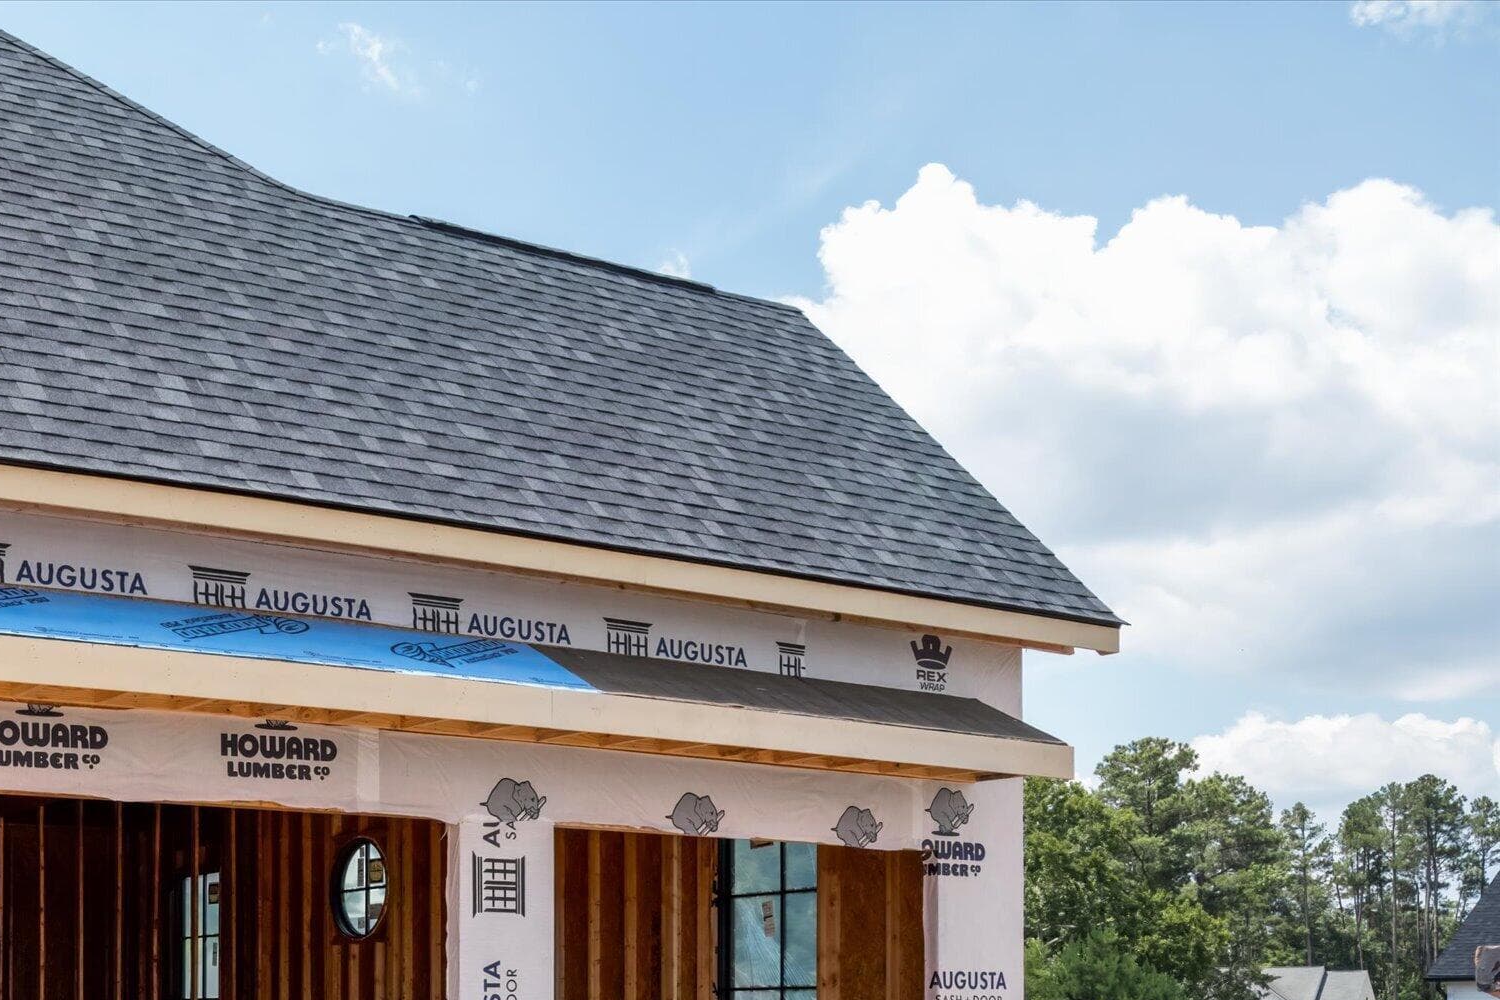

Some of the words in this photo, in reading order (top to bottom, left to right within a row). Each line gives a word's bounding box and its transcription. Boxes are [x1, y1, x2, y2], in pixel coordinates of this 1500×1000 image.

[15, 559, 148, 595] AUGUSTA
[254, 588, 372, 621] AUGUSTA
[466, 612, 572, 646] AUGUSTA
[655, 636, 748, 668] AUGUSTA
[916, 669, 947, 684] REX
[920, 682, 946, 692] WRAP
[220, 731, 338, 763] HOWARD
[226, 759, 311, 783] LUMBER
[929, 971, 1007, 990] AUGUSTA
